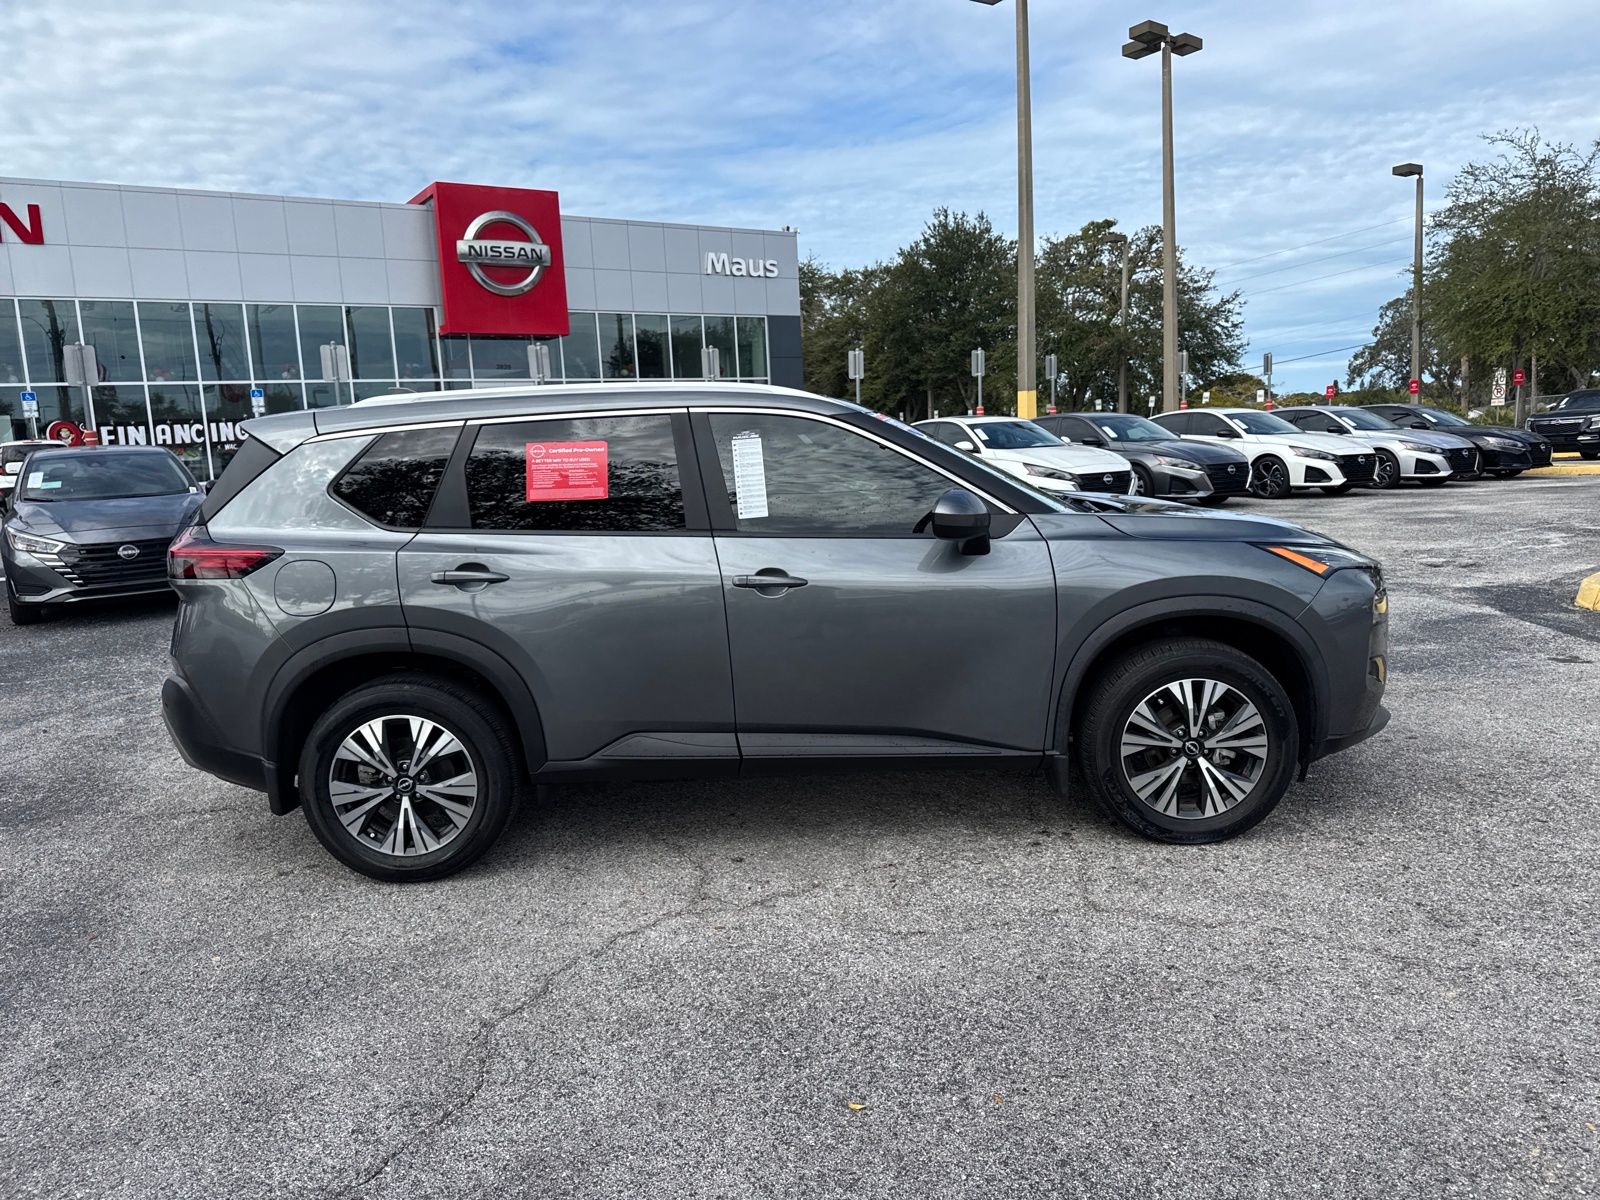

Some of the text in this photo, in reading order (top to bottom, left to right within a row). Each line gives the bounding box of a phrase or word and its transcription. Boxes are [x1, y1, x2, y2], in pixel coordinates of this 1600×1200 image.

[0, 202, 44, 245] N
[468, 244, 543, 260] NISSAN
[705, 251, 779, 278] Maus
[100, 422, 250, 446] FINANCING
